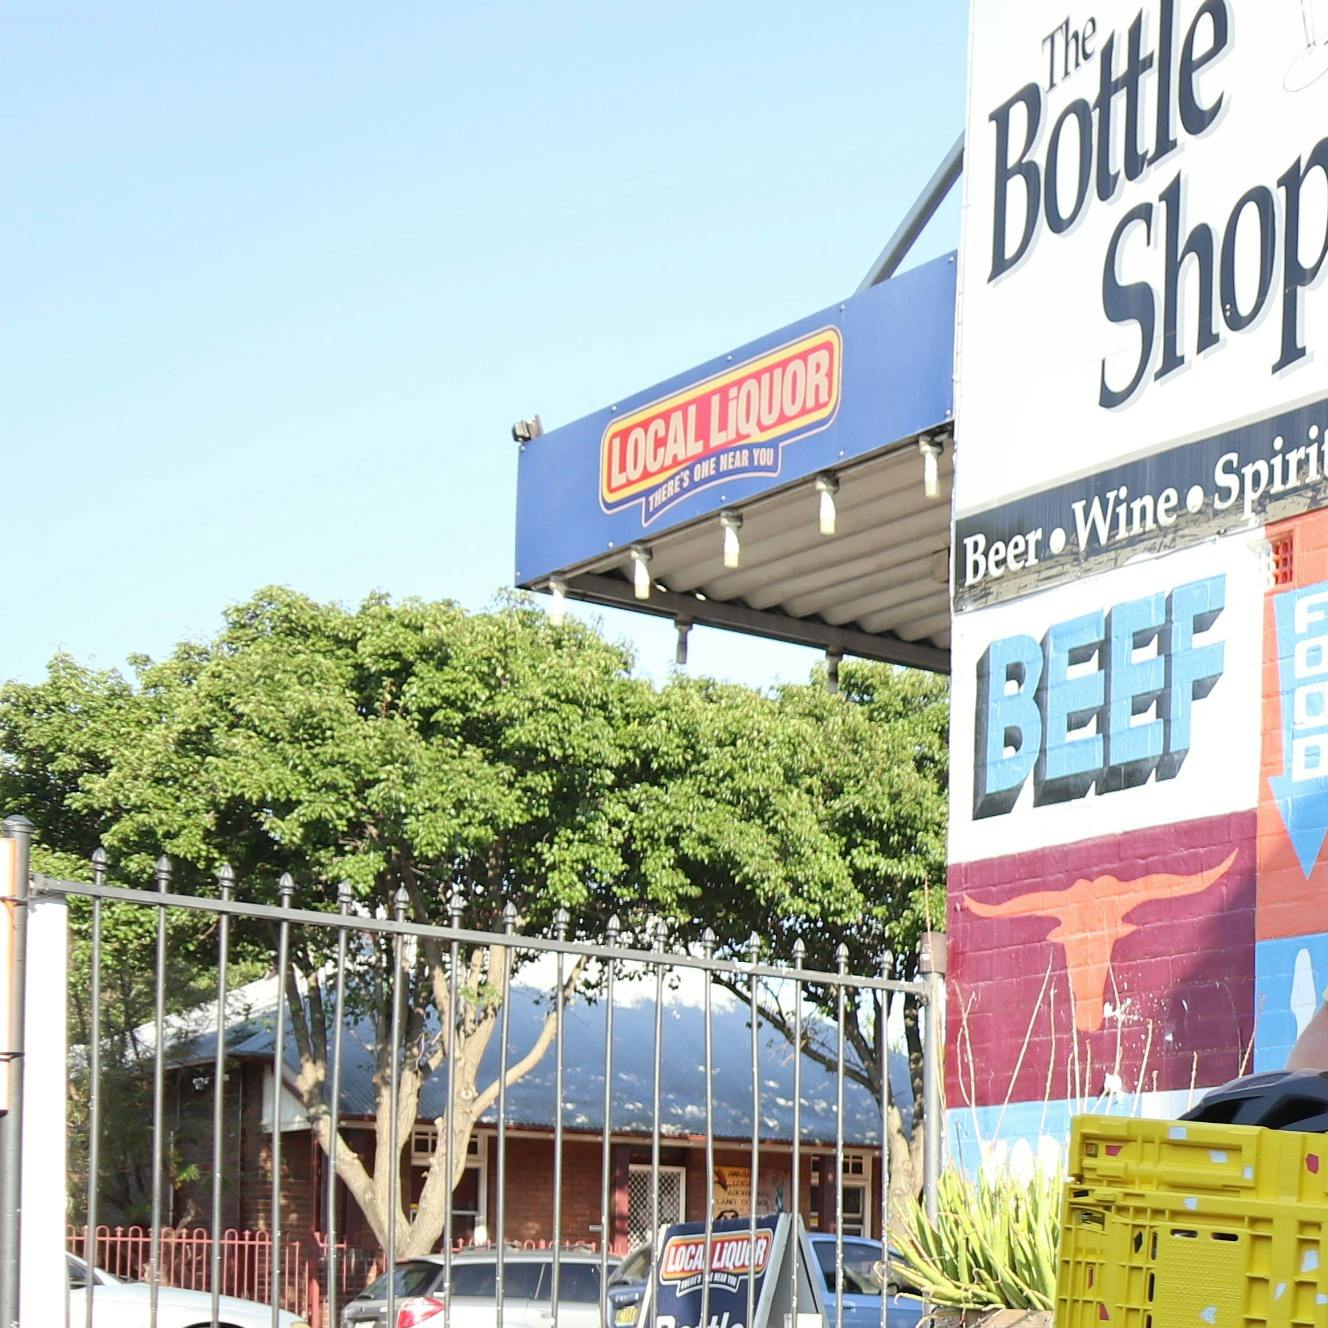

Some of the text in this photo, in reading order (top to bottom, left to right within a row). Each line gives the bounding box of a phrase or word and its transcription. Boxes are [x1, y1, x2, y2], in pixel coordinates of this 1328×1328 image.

[1041, 15, 1096, 94] The
[988, 0, 1230, 284] Bottle
[610, 403, 704, 489] LOCAL
[649, 447, 775, 512] THERE'S ONE NEAR YOU
[963, 525, 1043, 586] Beer
[1072, 484, 1180, 552] Wine
[972, 573, 1227, 820] BEEF
[667, 1244, 709, 1273] LOCA
